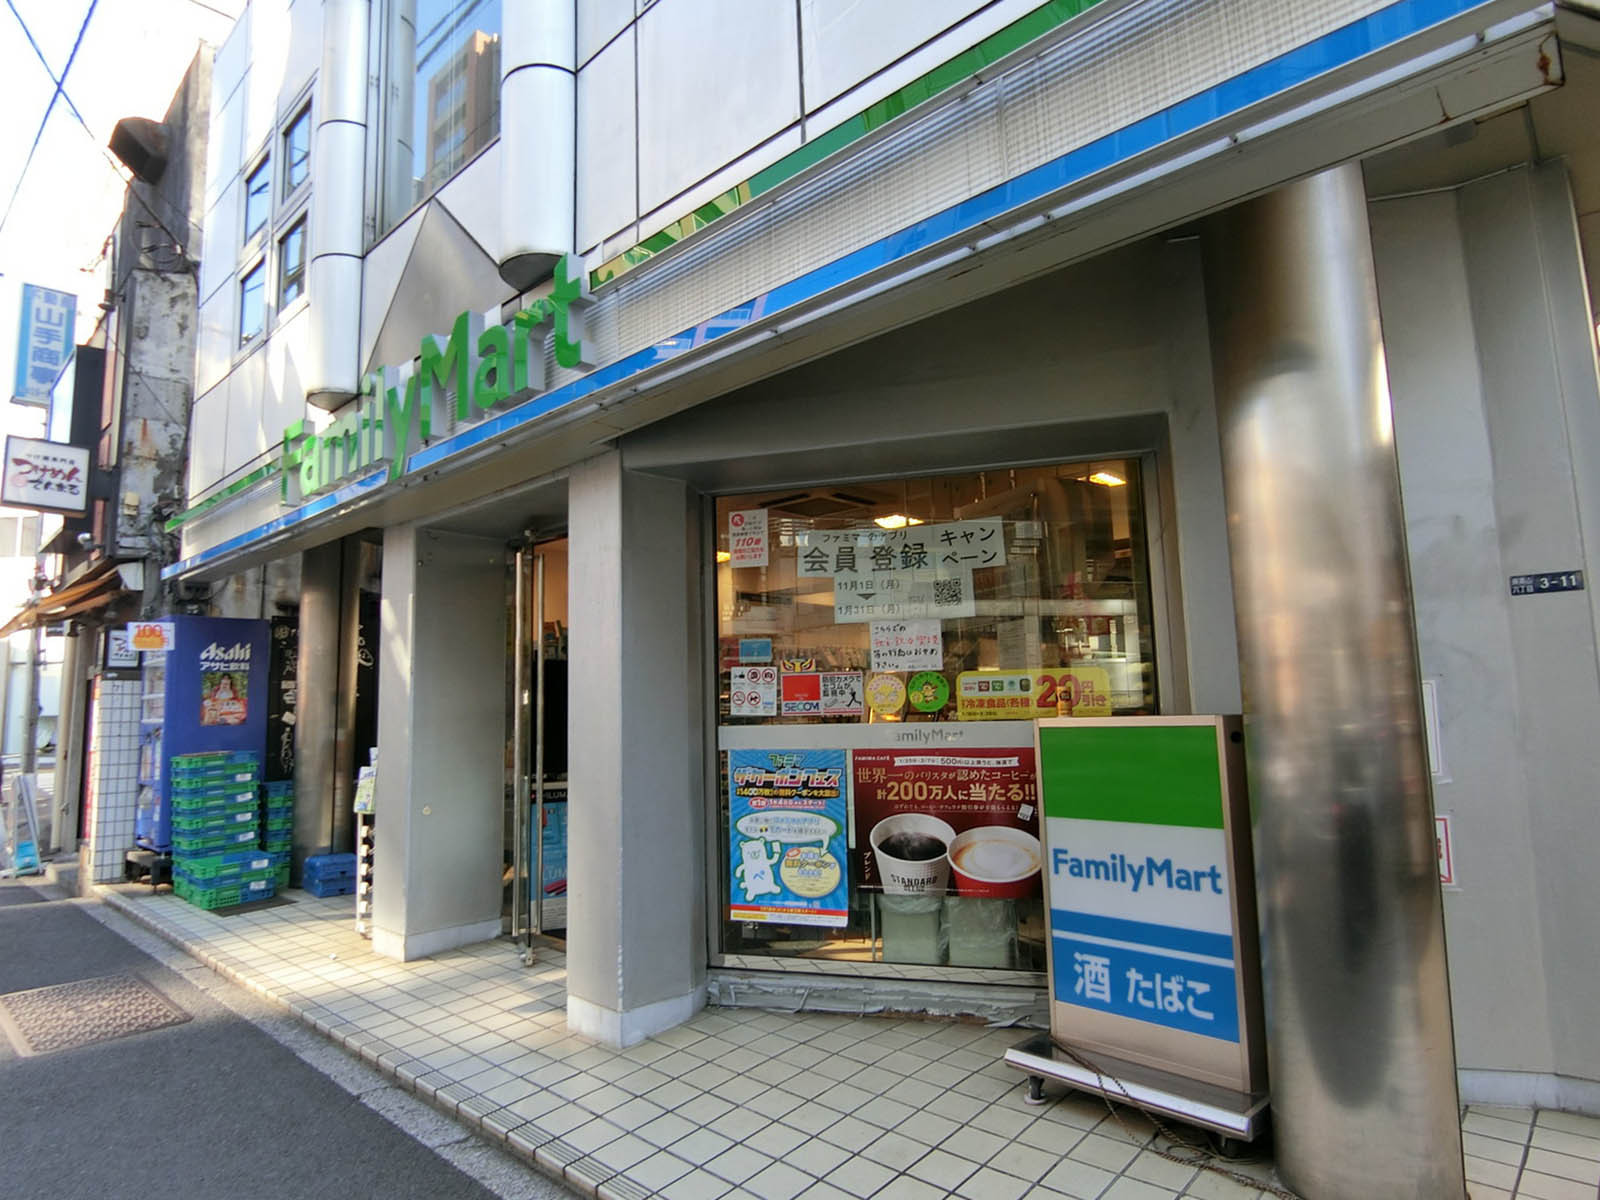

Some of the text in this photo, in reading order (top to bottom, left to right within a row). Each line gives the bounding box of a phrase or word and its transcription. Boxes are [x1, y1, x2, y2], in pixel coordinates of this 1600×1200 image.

[282, 252, 583, 506] FamilyMart
[939, 526, 996, 547] キャン
[941, 548, 998, 565] ペーン
[1540, 575, 1577, 589] 3-11
[200, 641, 251, 662] Asahi
[784, 701, 820, 712] SECOM
[890, 873, 938, 888] STANDARD
[1052, 847, 1224, 895] FamilyMart
[1073, 951, 1215, 1022] 酒 たばこ
